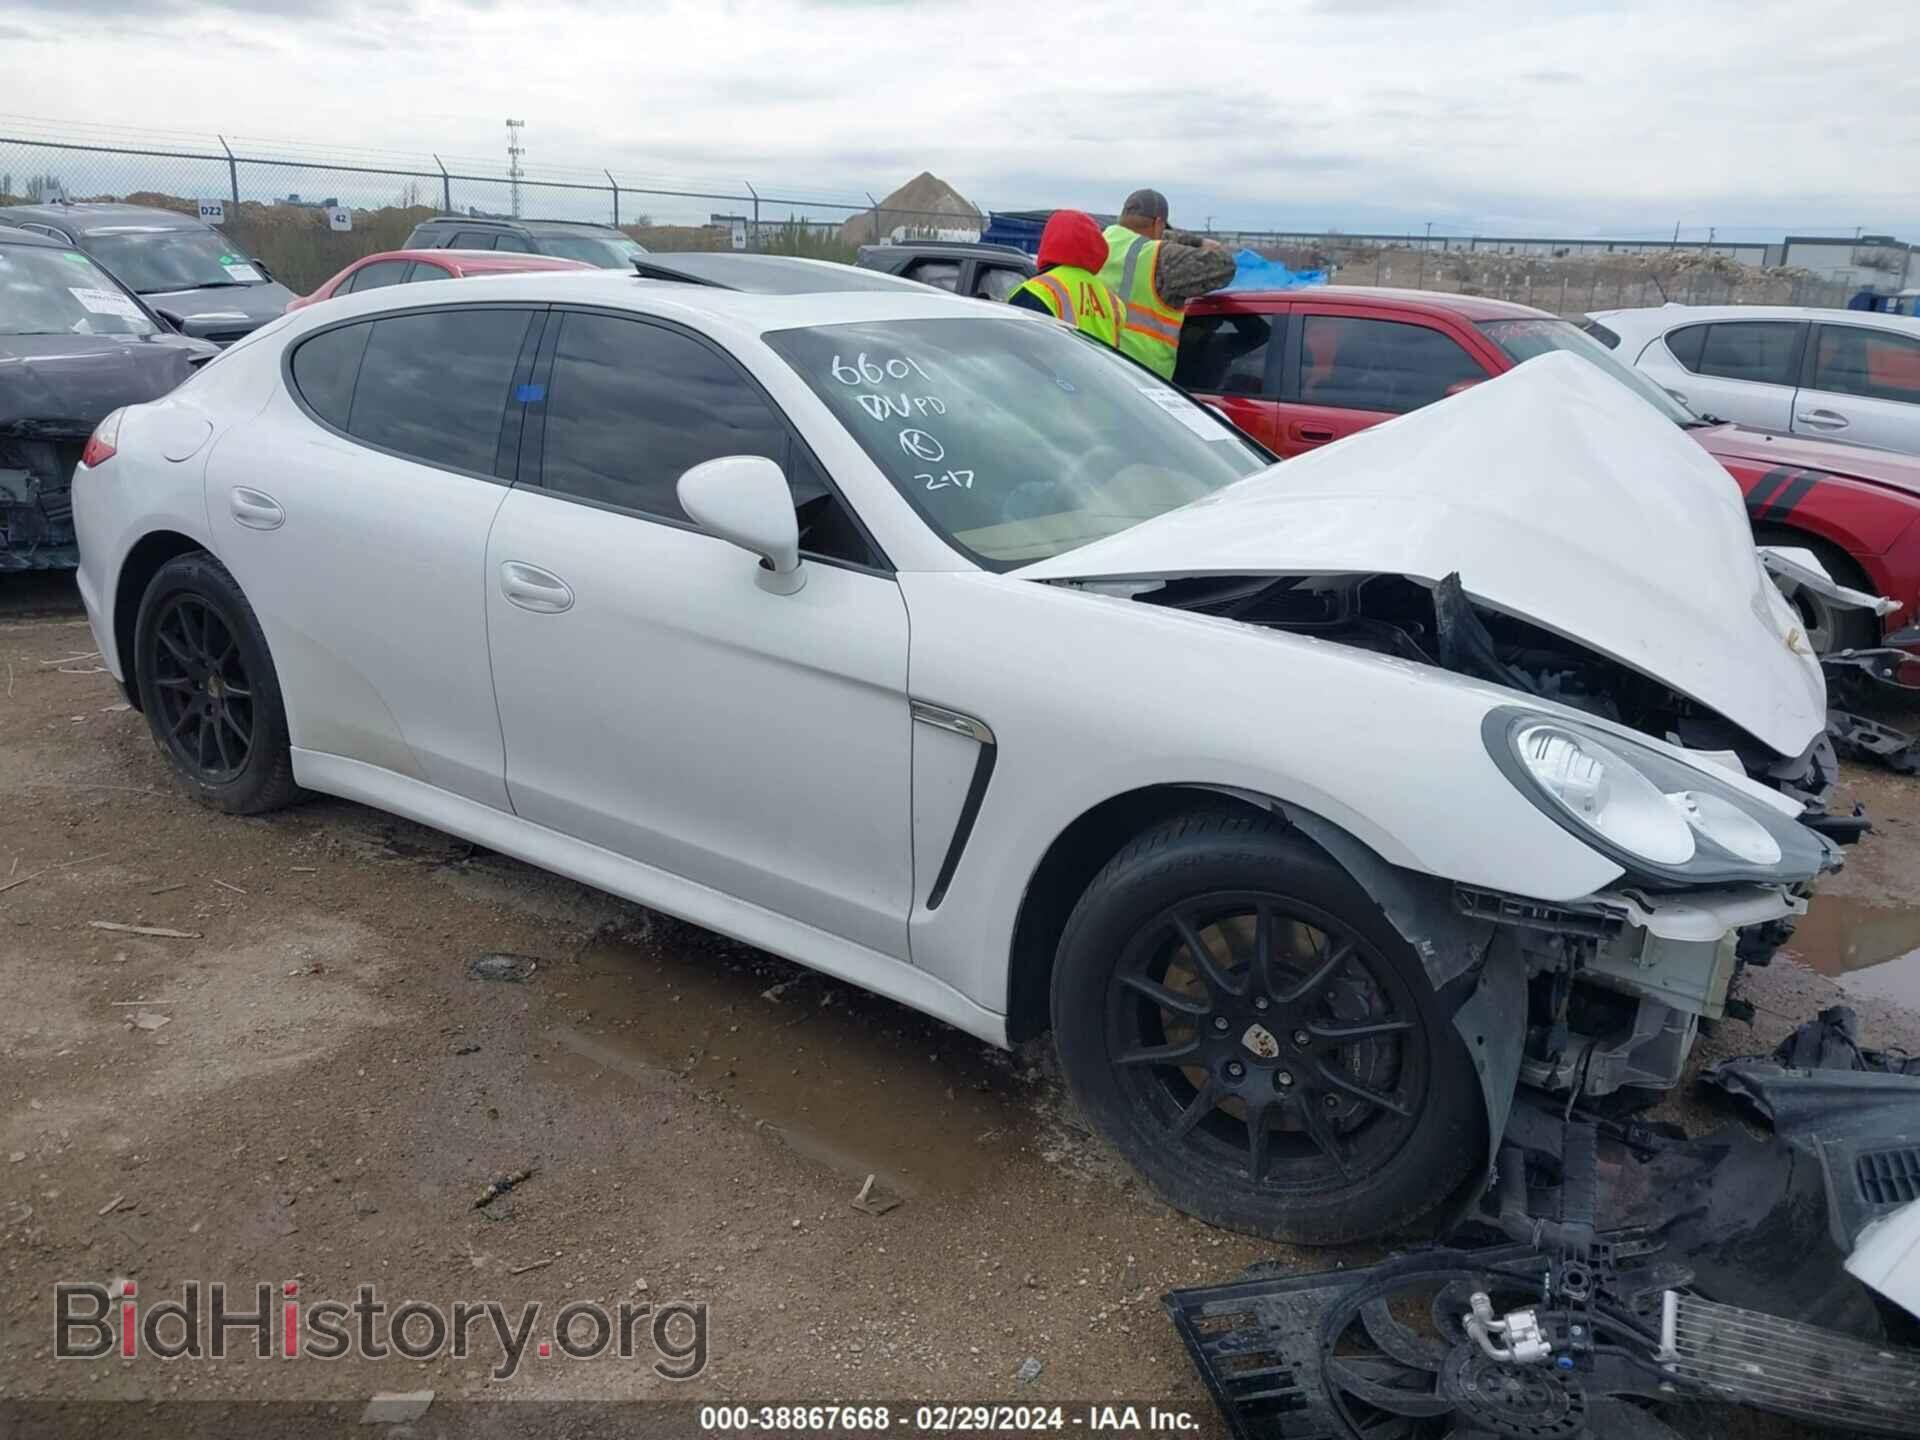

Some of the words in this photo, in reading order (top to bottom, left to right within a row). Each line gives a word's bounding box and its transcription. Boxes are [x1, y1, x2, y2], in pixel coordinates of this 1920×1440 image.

[200, 205, 222, 217] DZ2
[334, 213, 347, 224] 42
[832, 352, 931, 386] 6601
